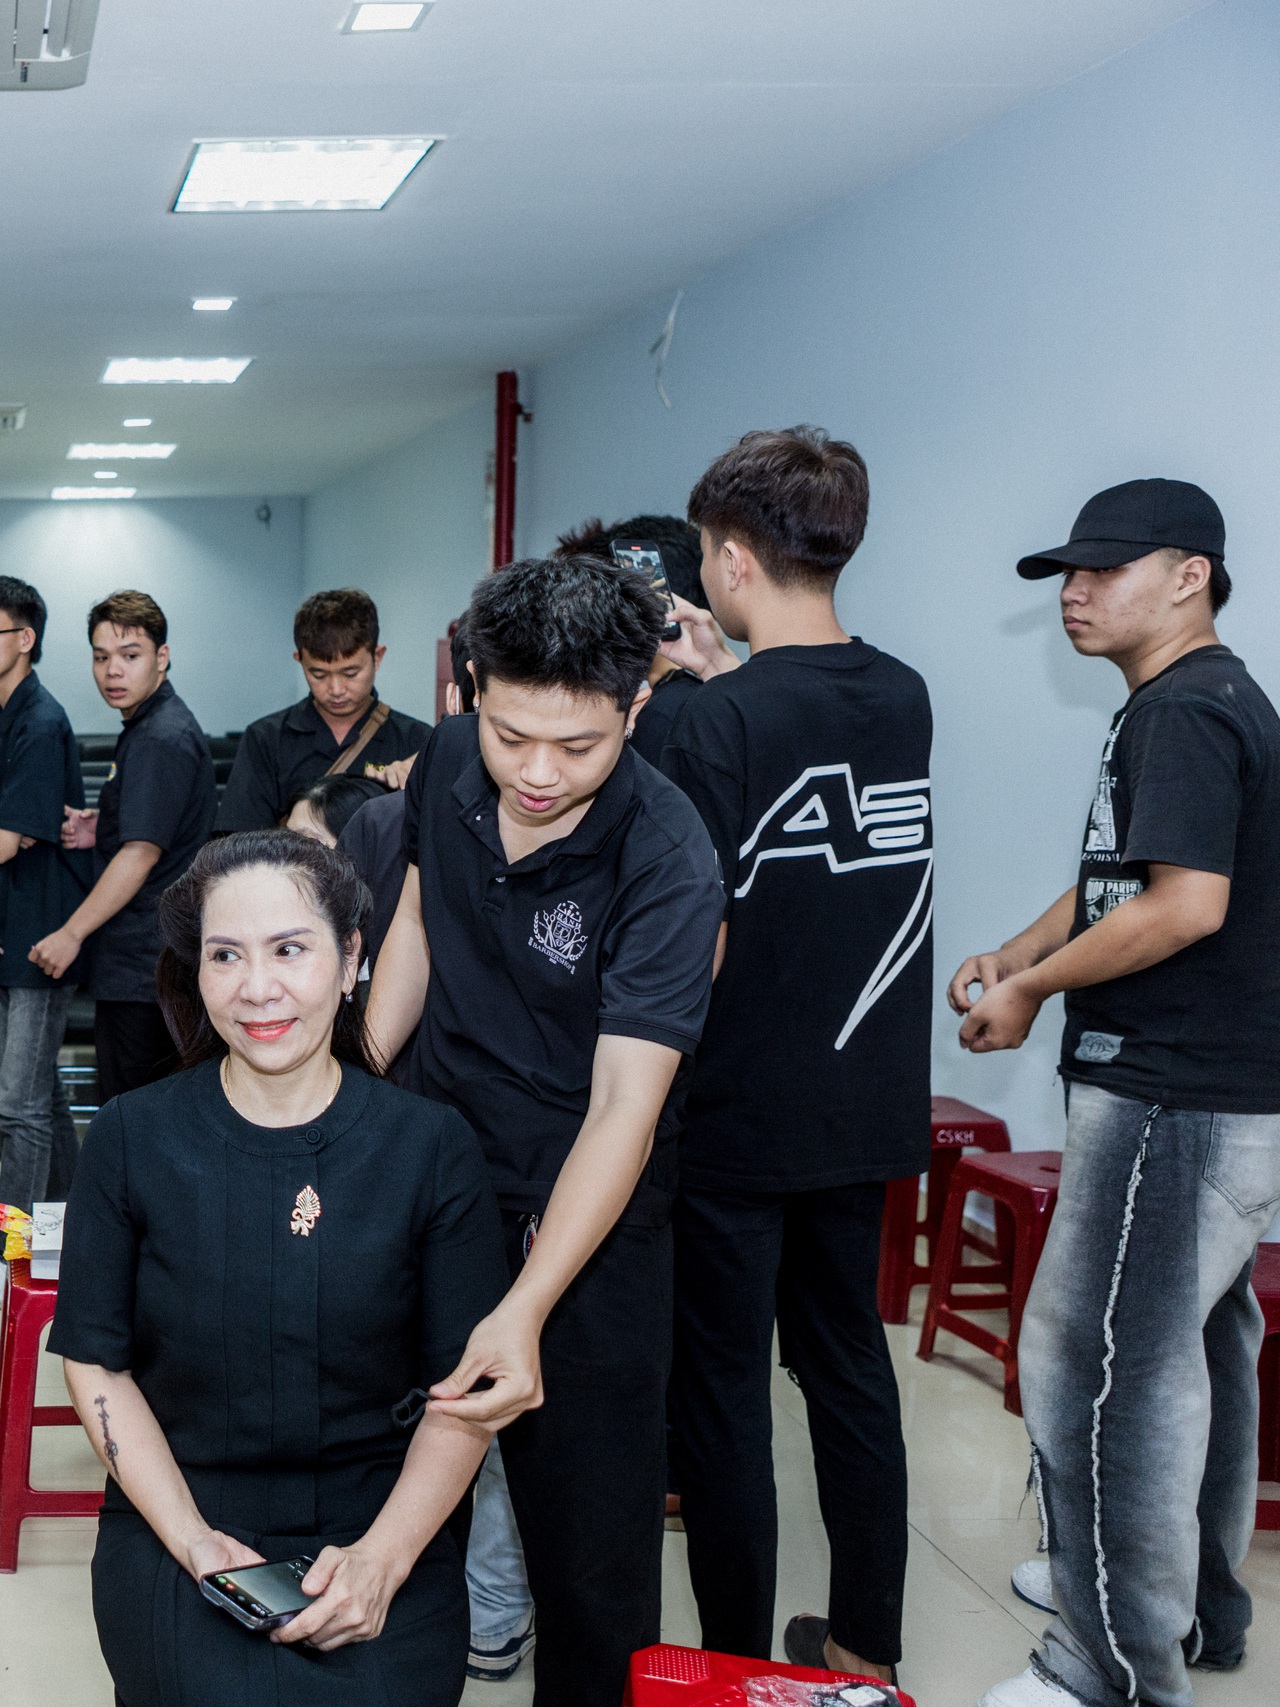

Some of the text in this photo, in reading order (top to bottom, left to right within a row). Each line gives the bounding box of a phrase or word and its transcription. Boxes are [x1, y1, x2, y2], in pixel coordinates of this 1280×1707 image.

[1106, 881, 1138, 894] PARIS
[532, 941, 573, 970] BARBERSHOP
[936, 1129, 975, 1144] CSKH
